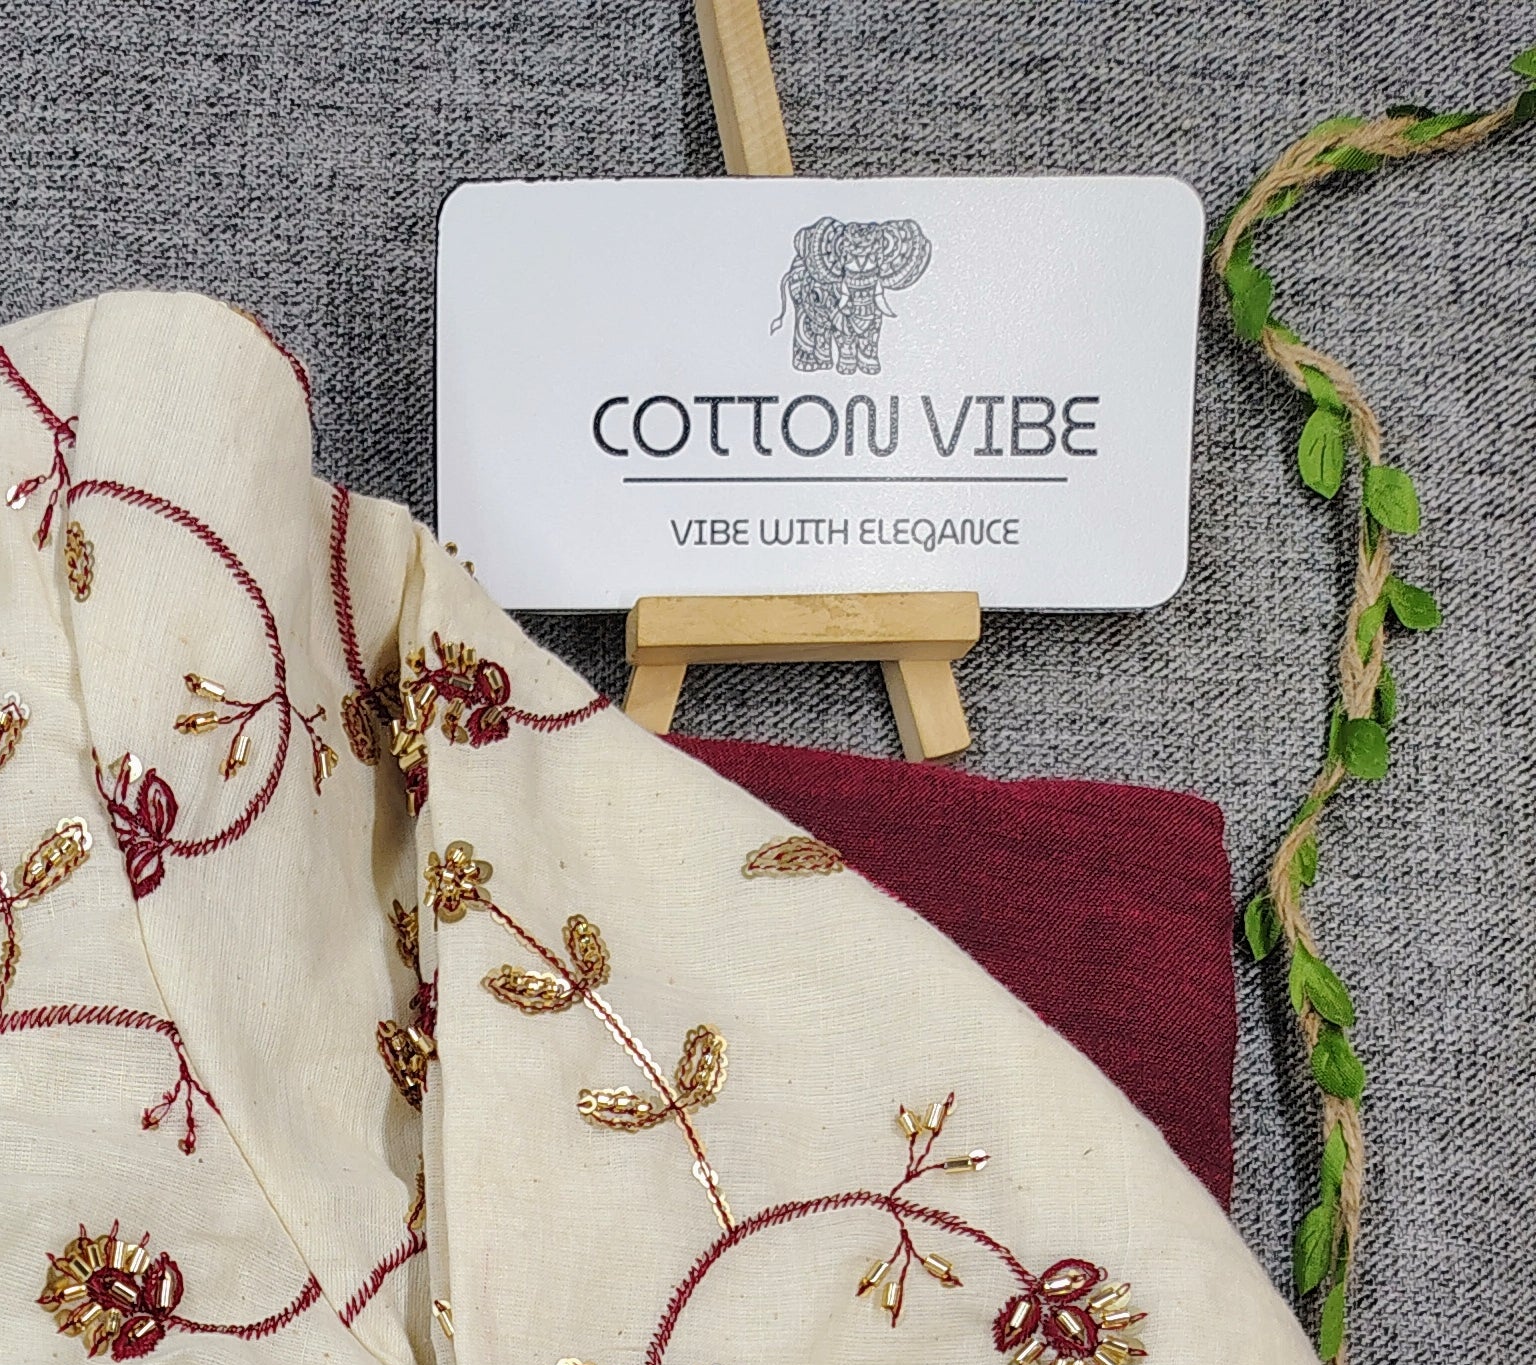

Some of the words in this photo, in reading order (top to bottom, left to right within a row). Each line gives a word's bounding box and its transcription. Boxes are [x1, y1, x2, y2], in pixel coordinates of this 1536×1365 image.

[592, 394, 900, 458] COTTON
[920, 394, 1101, 458] VIBE
[670, 518, 750, 547] VIBE
[759, 518, 849, 546] WITH
[859, 518, 1020, 553] ELEGANCE
